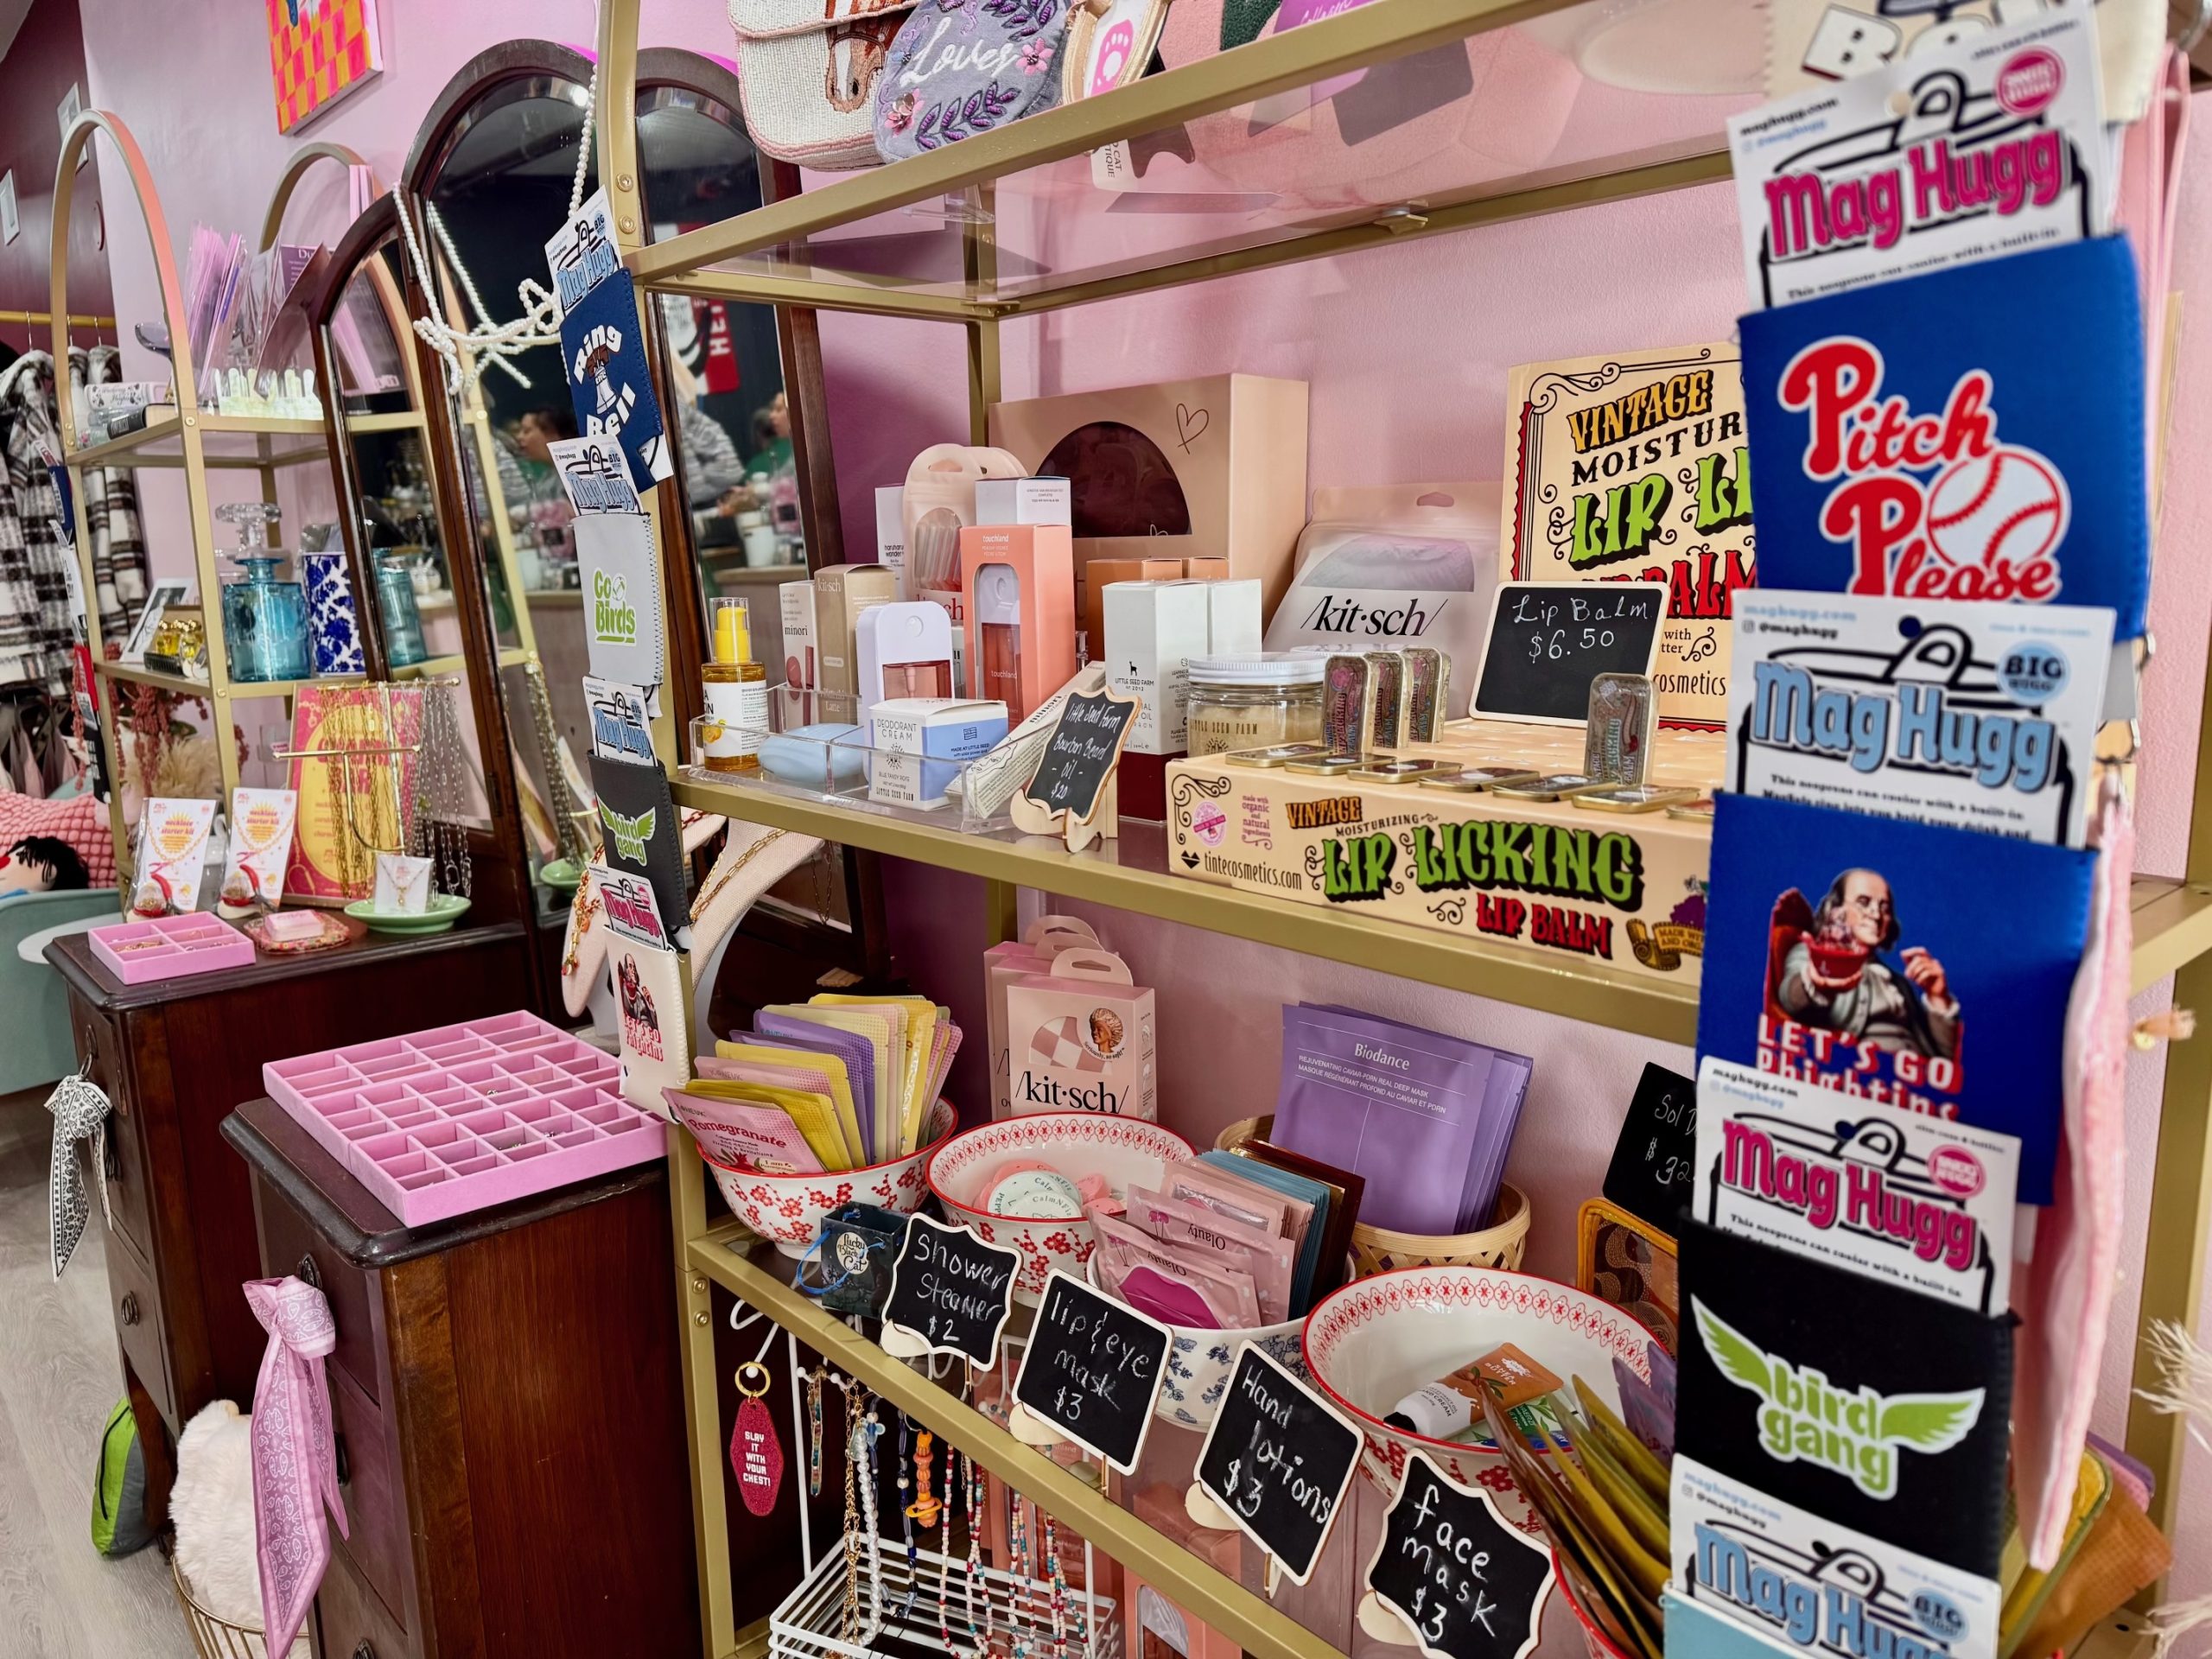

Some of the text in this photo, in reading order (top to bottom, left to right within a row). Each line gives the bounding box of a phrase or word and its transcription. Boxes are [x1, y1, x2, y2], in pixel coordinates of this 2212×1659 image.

[1764, 128, 2063, 257] Mag Hugg
[556, 238, 616, 308] Mag Hugg
[573, 324, 622, 385] Ring
[587, 381, 637, 437] Bell
[1566, 368, 1714, 454] VINTAGE
[1778, 336, 1997, 481] Pitch
[608, 453, 621, 463] BIG
[565, 470, 636, 513] Mag Hugg
[982, 532, 1009, 543] touchland
[1567, 473, 1675, 572] LIP
[1821, 474, 2062, 602] Please
[594, 569, 612, 600] Go
[594, 600, 636, 635] Birds
[1512, 594, 1649, 626] Lip Balm
[784, 625, 809, 636] minori
[1529, 628, 1615, 664] $6.50
[1663, 628, 1692, 641] with
[991, 670, 1018, 679] touchland
[2003, 652, 2064, 680] BIG
[876, 718, 918, 731] DEODORANT
[1029, 695, 1063, 724] minori
[1141, 712, 1153, 721] OIL
[593, 705, 652, 760] Mag Hugg
[881, 728, 913, 741] CREAM
[1211, 722, 1230, 734] SEED
[1235, 722, 1258, 735] FARM
[1752, 659, 2056, 794] Mag Hugg
[1082, 736, 1114, 762] Beard
[1242, 802, 1270, 814] organic
[1243, 817, 1270, 830] natural
[1285, 796, 1363, 830] VINTAGE
[612, 811, 641, 842] bird
[1335, 813, 1420, 837] MOISTURIZING
[616, 837, 645, 866] gang
[1322, 818, 1646, 913] LIP LICKING
[1205, 849, 1303, 891] tintecosmetics.com
[1476, 891, 1614, 961] LIP BALM
[1084, 1040, 1106, 1060] Seriously,
[1354, 1042, 1411, 1071] Biodance
[1758, 1012, 1963, 1095] LET'S GO
[1298, 1054, 1342, 1072] REJUVENATING
[1377, 1077, 1394, 1088] REAL
[1393, 1080, 1411, 1092] DEEP
[1411, 1084, 1429, 1098] MASK
[1298, 1064, 1324, 1077] MASQUE
[1359, 1082, 1386, 1096] PROFOND
[1386, 1089, 1395, 1098] AU
[1395, 1091, 1419, 1106] CAVIAR
[1418, 1098, 1427, 1108] ET
[1427, 1101, 1446, 1115] PDRN
[1654, 1093, 1685, 1128] Sol
[686, 1117, 788, 1149] Pomegranate
[1722, 1117, 1977, 1272] Mag Hugg
[843, 1234, 867, 1251] Lucky
[1186, 1223, 1227, 1251] Olauty
[843, 1256, 865, 1273] Cat
[913, 1233, 1009, 1291] Shower
[1147, 1249, 1187, 1277] Olauty
[928, 1314, 961, 1342] $2
[1053, 1348, 1122, 1413] mask
[1241, 1363, 1294, 1430] Hand
[1053, 1384, 1084, 1421] $3
[1433, 1394, 1452, 1418] CREAM
[1774, 1362, 1878, 1442] bird
[744, 1430, 765, 1443] SLAY
[751, 1442, 760, 1452] IT
[1763, 1408, 1891, 1493] gang
[745, 1452, 766, 1465] WITH
[745, 1462, 767, 1475] YOUR
[1249, 1419, 1332, 1525] lotions
[742, 1471, 771, 1487] CHEST!
[1223, 1458, 1264, 1518] $3
[1414, 1483, 1491, 1583] face
[1694, 1521, 1818, 1645] Mag
[1913, 1592, 1965, 1632] BIG
